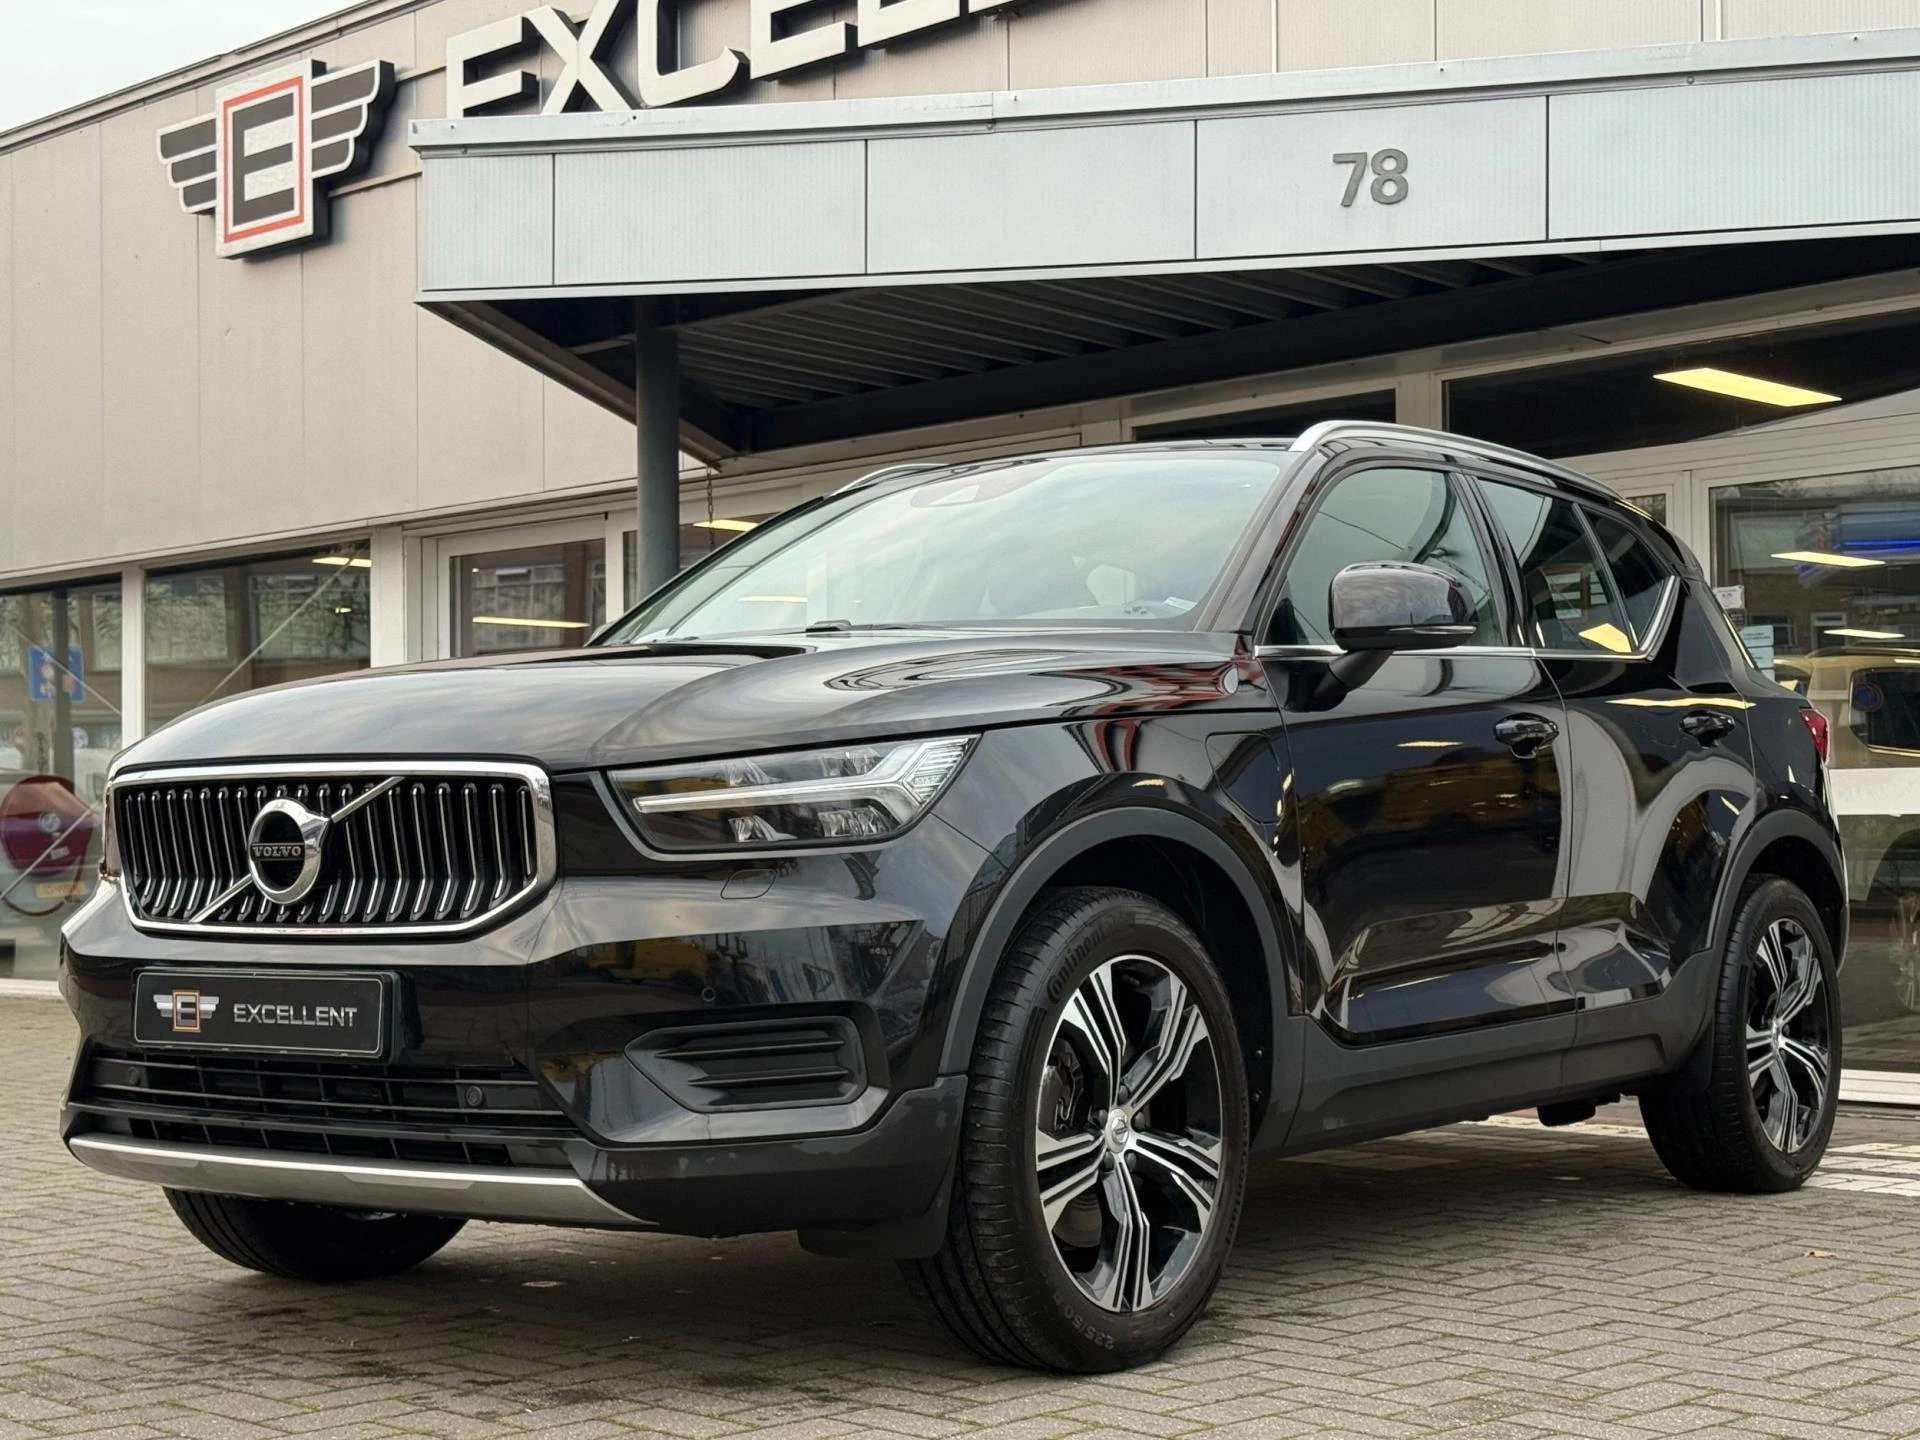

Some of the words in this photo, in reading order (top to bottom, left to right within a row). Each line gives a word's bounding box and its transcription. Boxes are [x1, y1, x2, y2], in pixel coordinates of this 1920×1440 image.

[1332, 148, 1409, 207] 78
[252, 846, 302, 858] VOLVO
[233, 1004, 358, 1027] EXCELLENT
